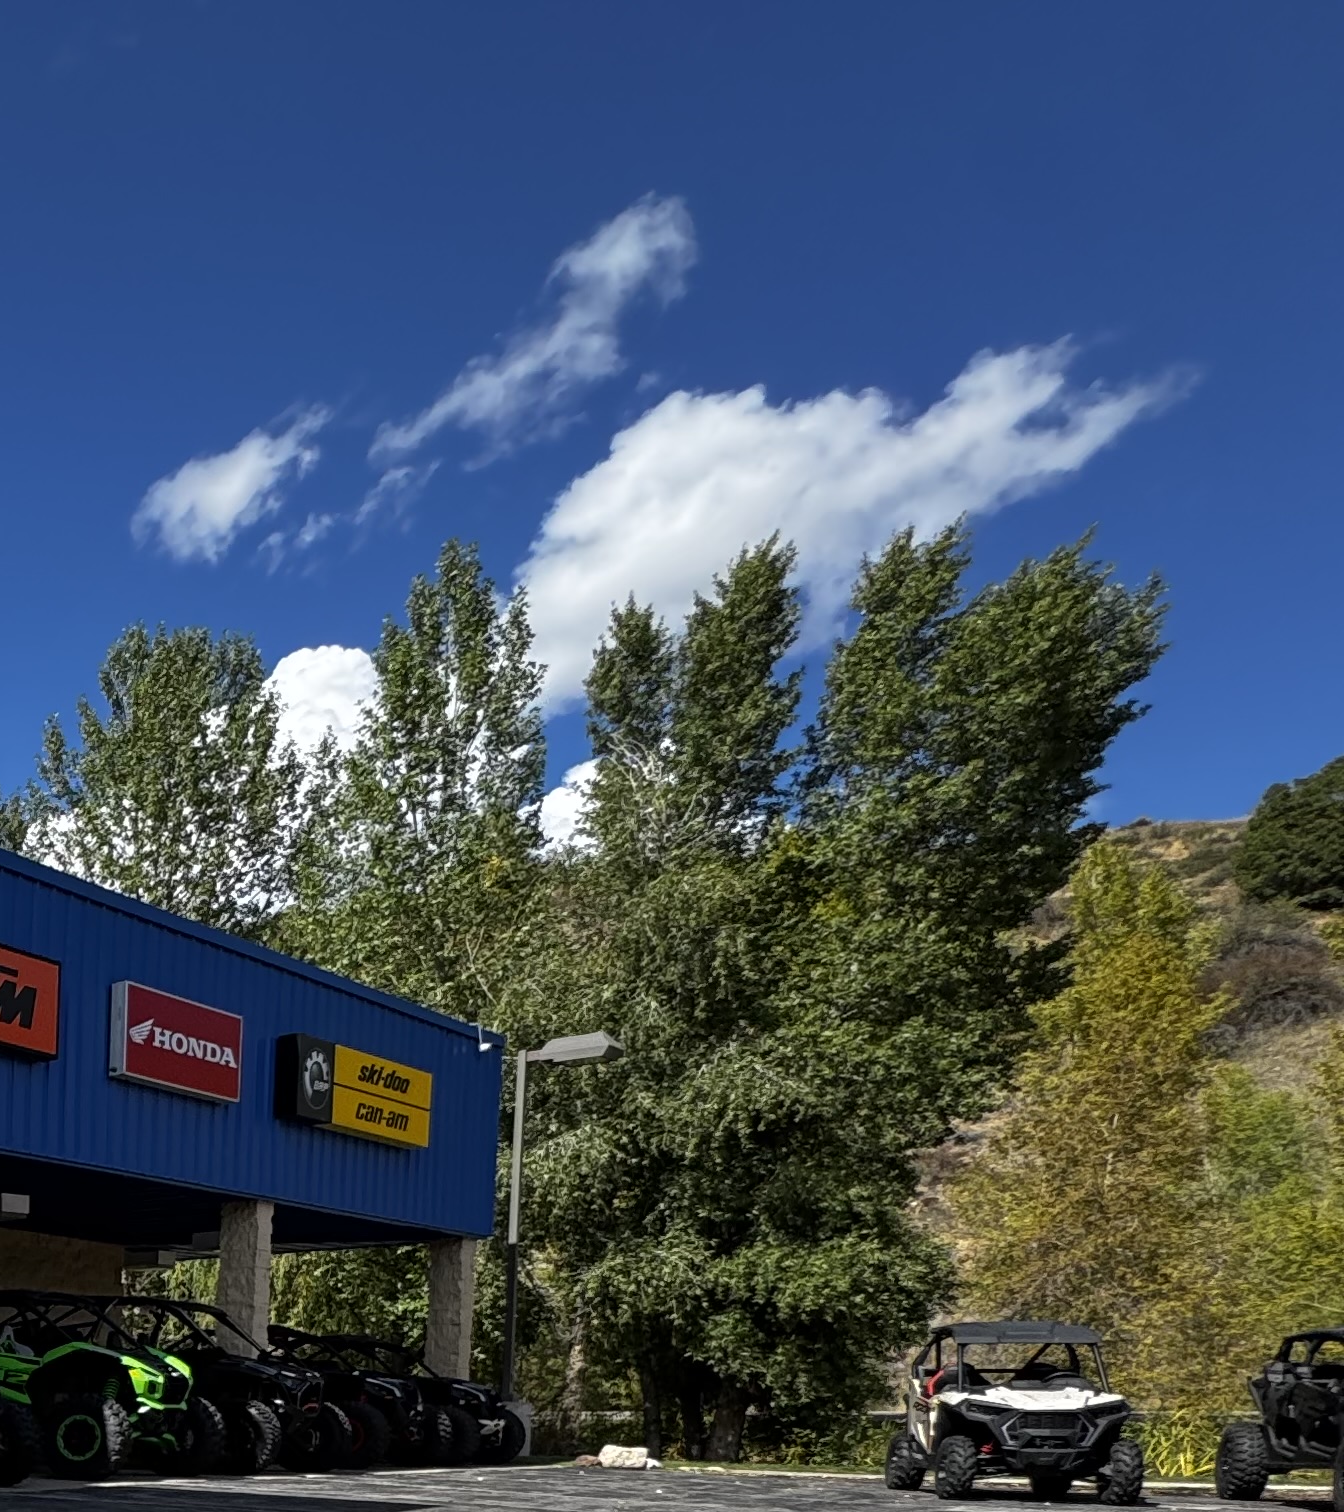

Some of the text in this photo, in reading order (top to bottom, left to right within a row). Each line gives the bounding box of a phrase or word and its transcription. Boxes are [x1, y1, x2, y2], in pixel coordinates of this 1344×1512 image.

[152, 1025, 238, 1069] HONDA
[358, 1064, 411, 1094] ski-doo
[356, 1103, 410, 1131] can-am
